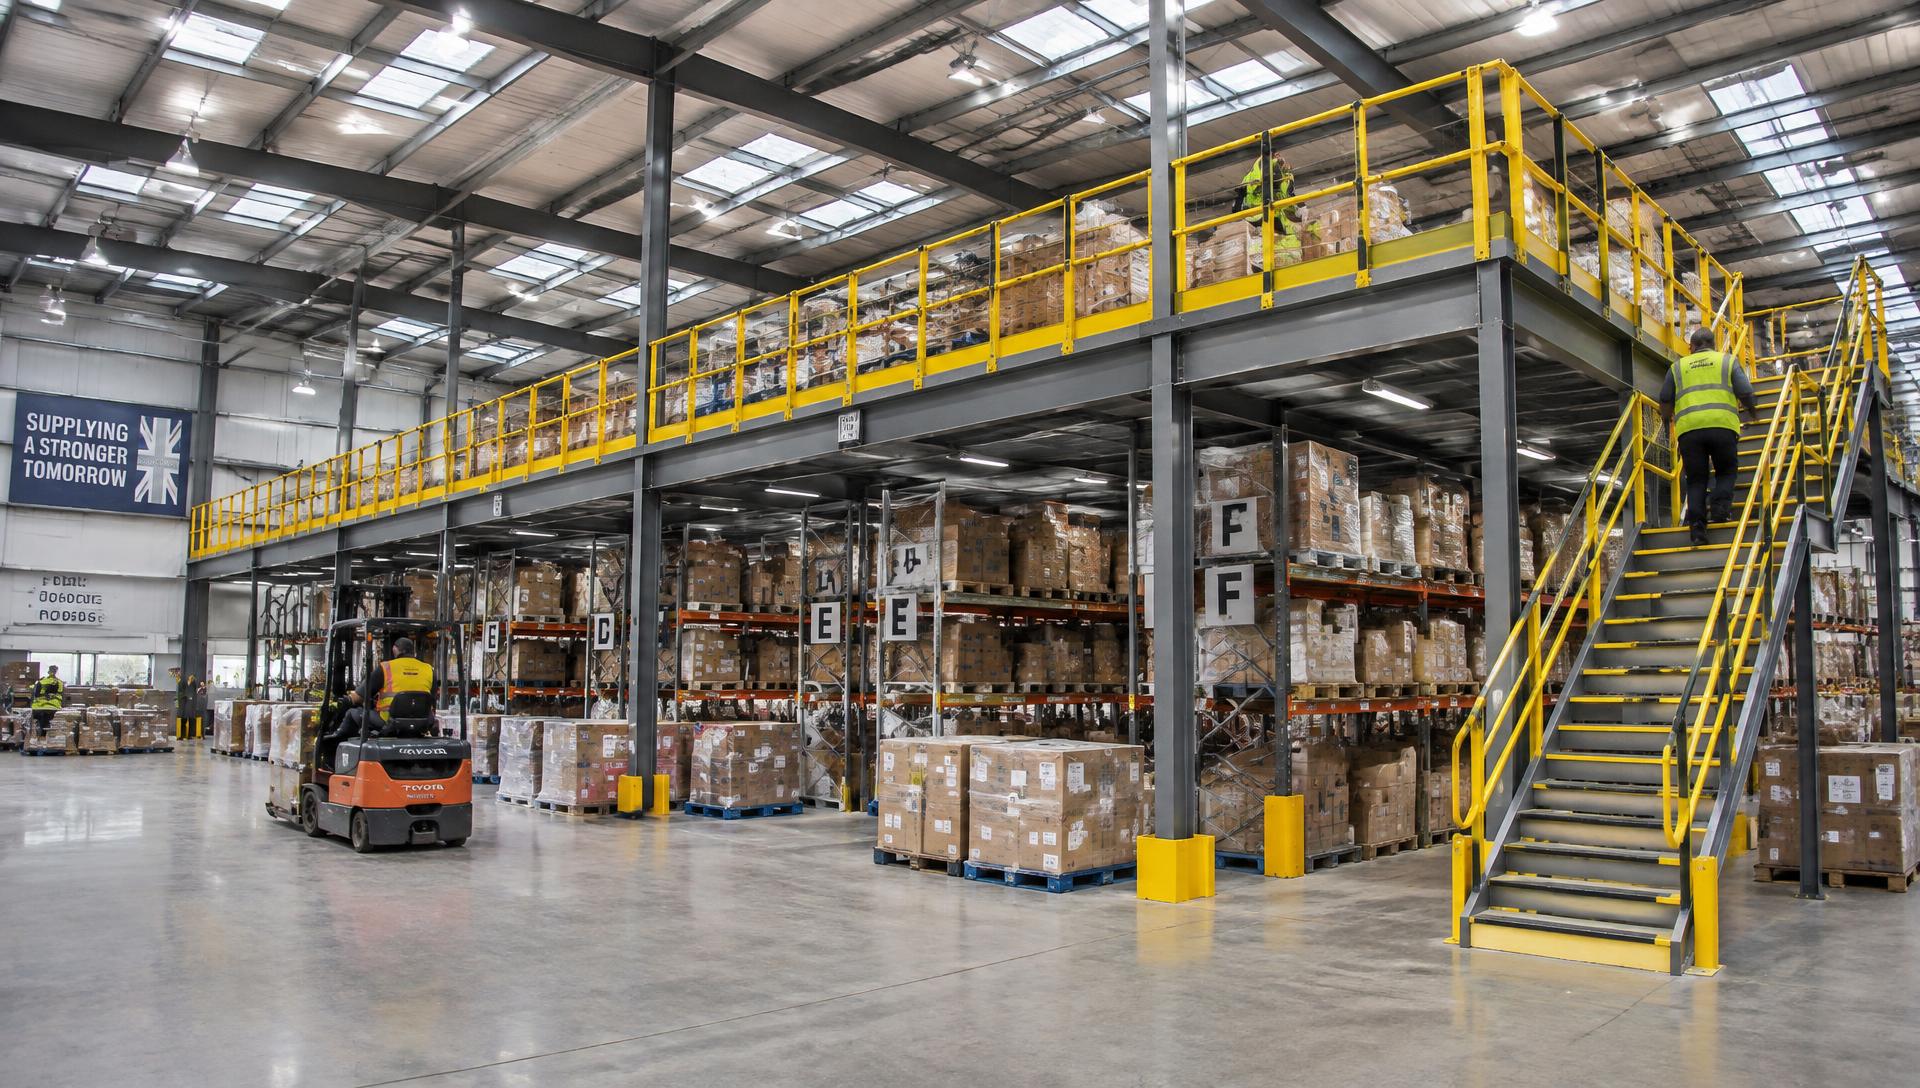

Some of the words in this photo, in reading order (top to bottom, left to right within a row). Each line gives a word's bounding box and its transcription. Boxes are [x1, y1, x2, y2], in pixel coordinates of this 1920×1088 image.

[26, 412, 129, 442] SUPPLYING
[23, 435, 35, 455] A
[39, 437, 128, 465] STRONGER
[23, 458, 127, 488] TOMORROW
[1222, 502, 1247, 547] F
[1217, 571, 1242, 615] F
[818, 607, 833, 639] E
[892, 598, 909, 636] E
[488, 624, 497, 649] E
